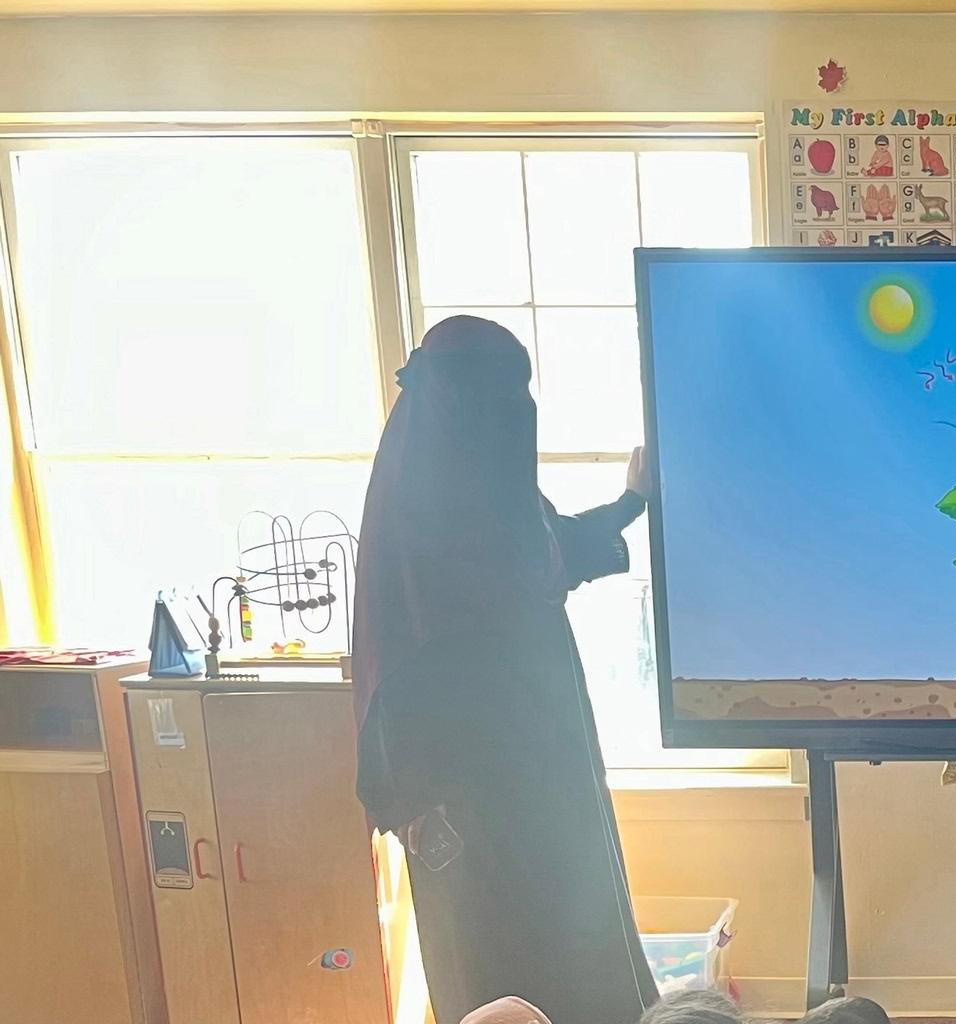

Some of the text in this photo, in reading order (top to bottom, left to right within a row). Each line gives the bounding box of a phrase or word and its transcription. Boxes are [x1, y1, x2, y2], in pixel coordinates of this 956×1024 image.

[790, 108, 824, 129] My
[830, 108, 885, 127] First
[793, 138, 802, 149] A
[848, 138, 856, 149] B
[902, 138, 912, 149] C
[794, 155, 801, 163] a
[848, 154, 856, 163] b
[903, 154, 910, 162] c
[796, 186, 803, 196] E
[851, 186, 857, 196] F
[903, 185, 913, 196] G
[852, 232, 858, 243] J
[906, 232, 914, 243] K
